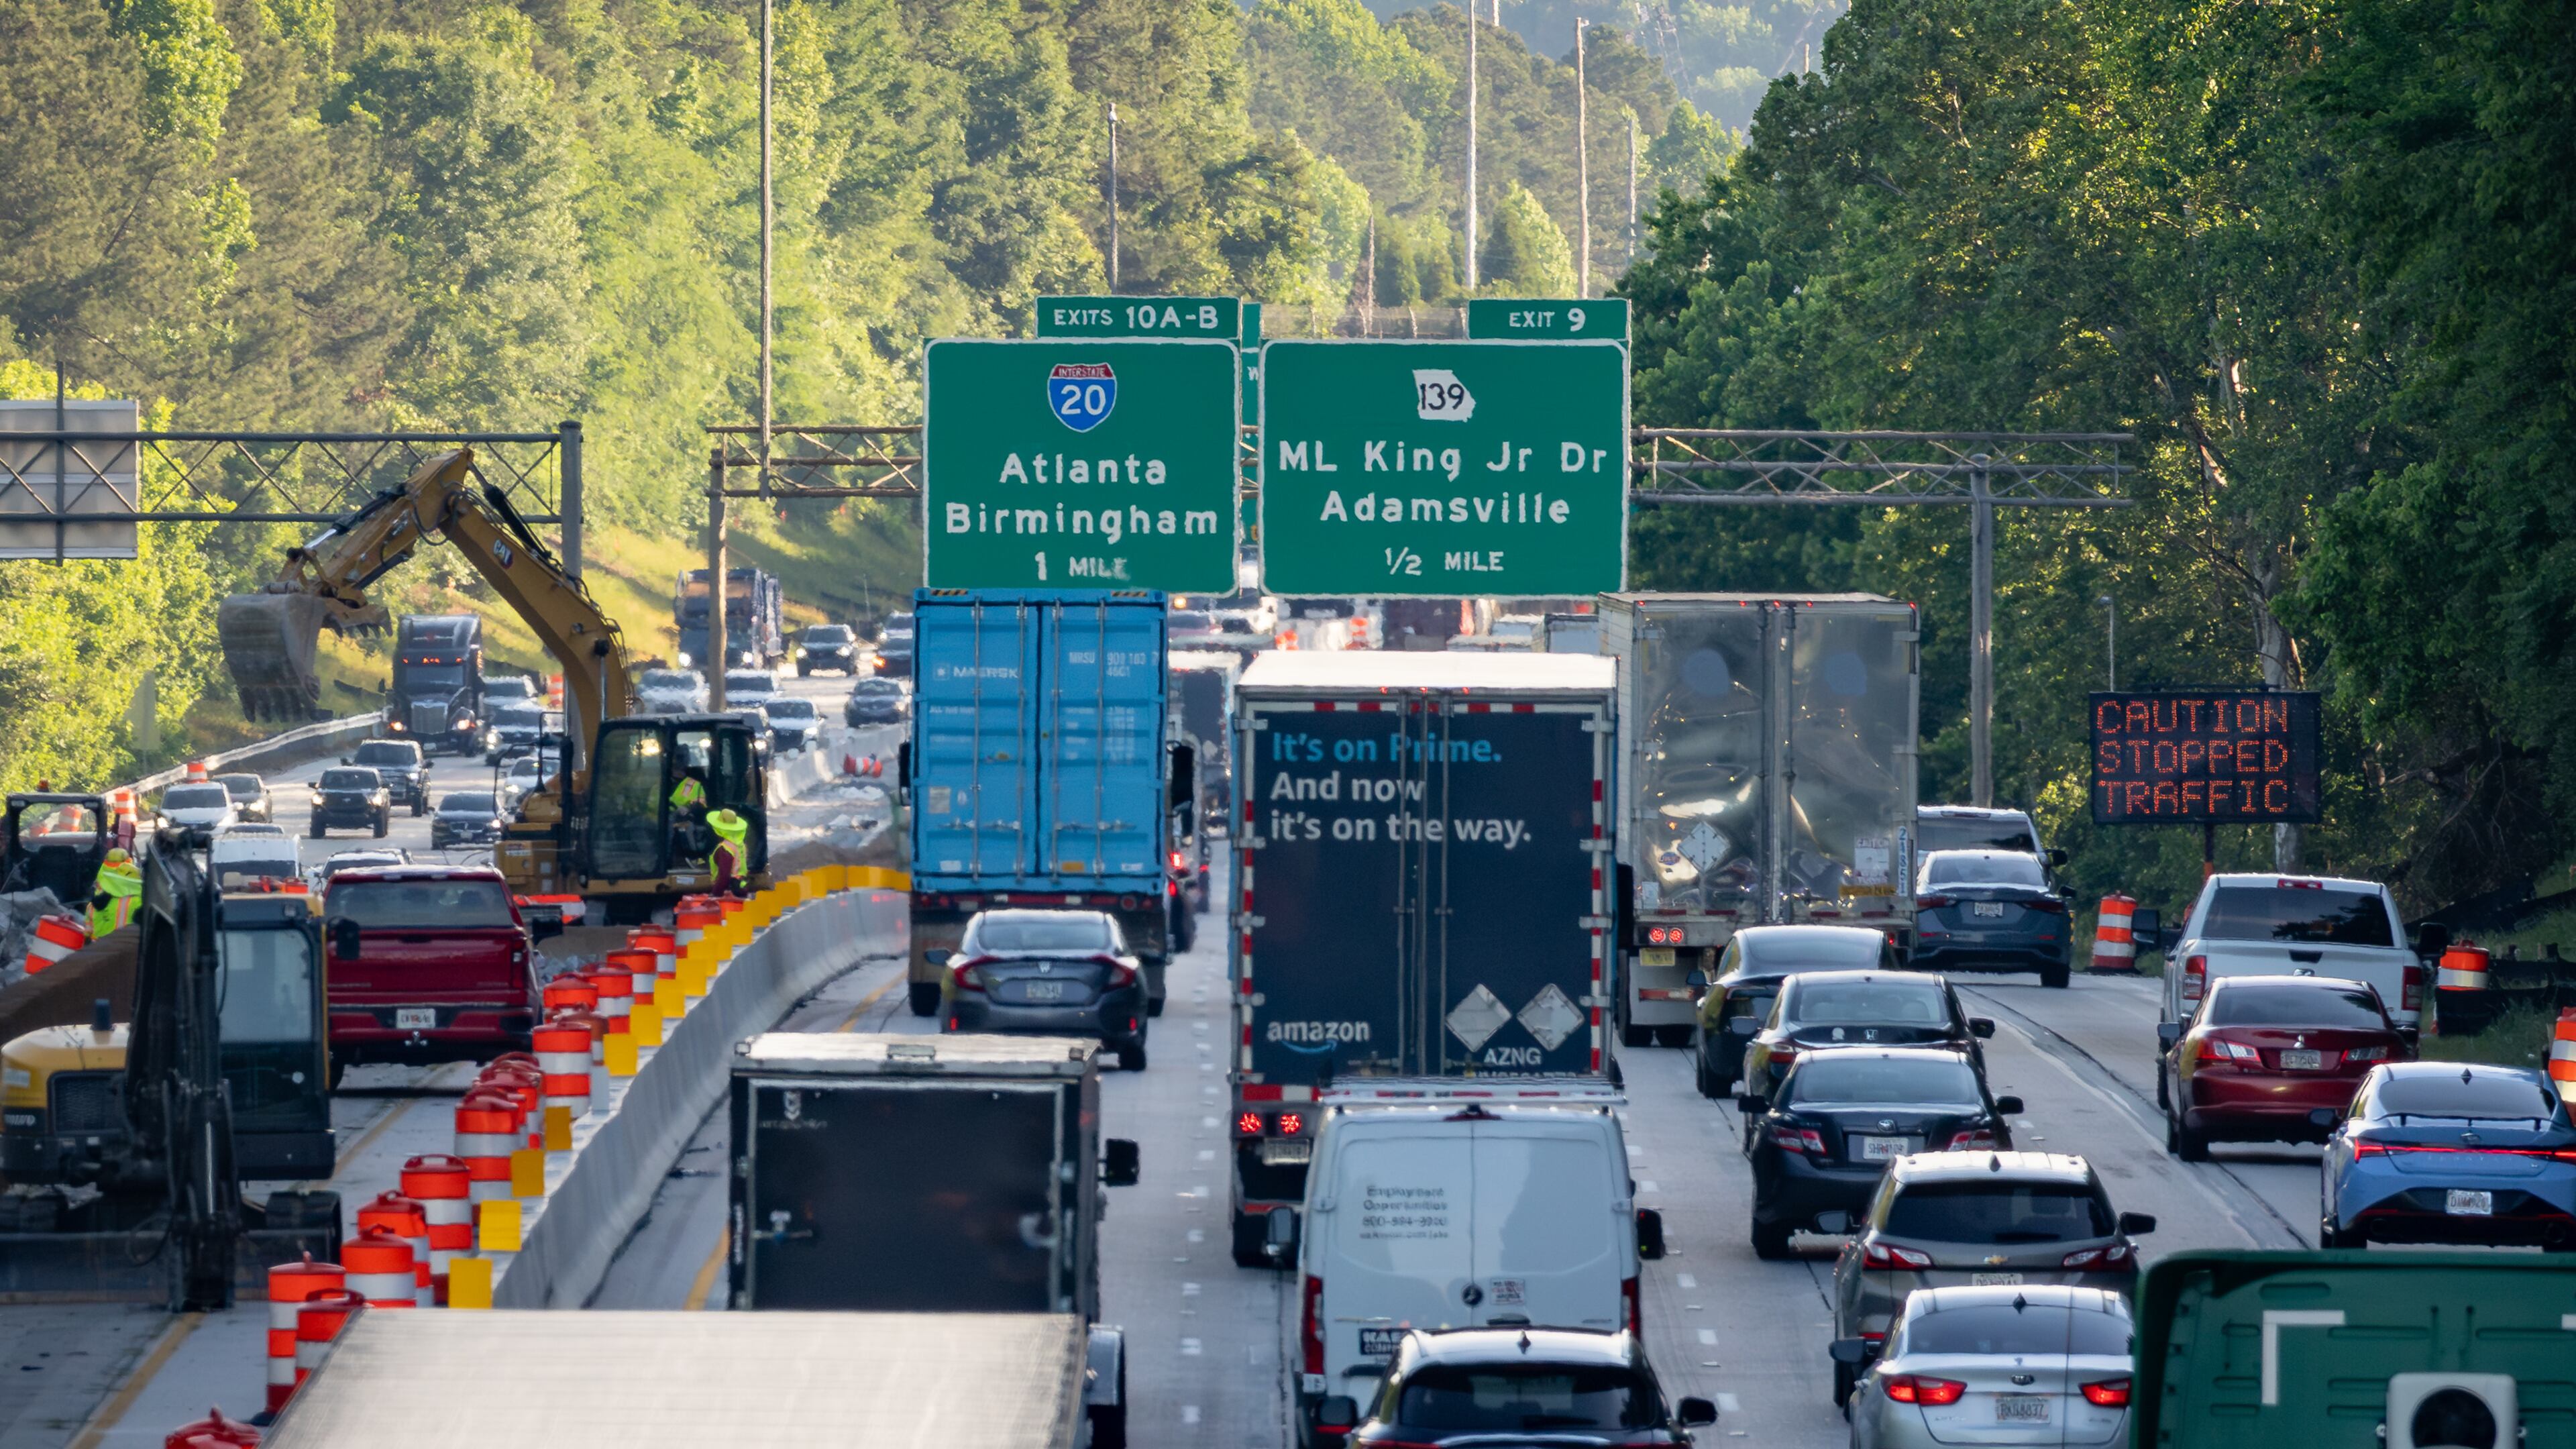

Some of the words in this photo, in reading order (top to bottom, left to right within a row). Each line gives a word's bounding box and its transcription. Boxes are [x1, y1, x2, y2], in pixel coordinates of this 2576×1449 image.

[1054, 309, 1113, 325] EXITS
[1126, 305, 1218, 329] 10A-B
[1509, 311, 1555, 327] EXIT
[1568, 308, 1585, 331] 9
[1059, 367, 1106, 377] INTERSTATE
[1061, 384, 1106, 415] 20
[1419, 383, 1464, 411] 139
[1000, 453, 1166, 484] Atlanta
[1280, 441, 1337, 471] ML
[1365, 441, 1460, 482] King
[1487, 442, 1532, 472] Jr
[1561, 442, 1606, 472] Dr
[1320, 491, 1569, 523] Adamsville
[947, 502, 1217, 544] Birmingham
[493, 539, 512, 565] CAT
[1035, 552, 1046, 580] 1
[1069, 557, 1126, 579] MILE
[1445, 551, 1503, 571] MILE
[953, 666, 1018, 678] MAERSK
[2096, 700, 2288, 734] CAUTION
[1273, 733, 1324, 762] It's
[1334, 740, 1376, 763] on
[1390, 733, 1501, 762] Prime.
[2098, 739, 2288, 773] STOPPED
[1271, 771, 1340, 800] And
[1352, 778, 1425, 802] now
[2098, 780, 2288, 814] TRAFFIC
[1271, 810, 1322, 841] it's
[1332, 817, 1375, 841] on
[1387, 811, 1444, 841] the
[1454, 819, 1531, 850] way.
[1267, 1020, 1371, 1042] amazon
[1483, 1046, 1542, 1066] AZNG
